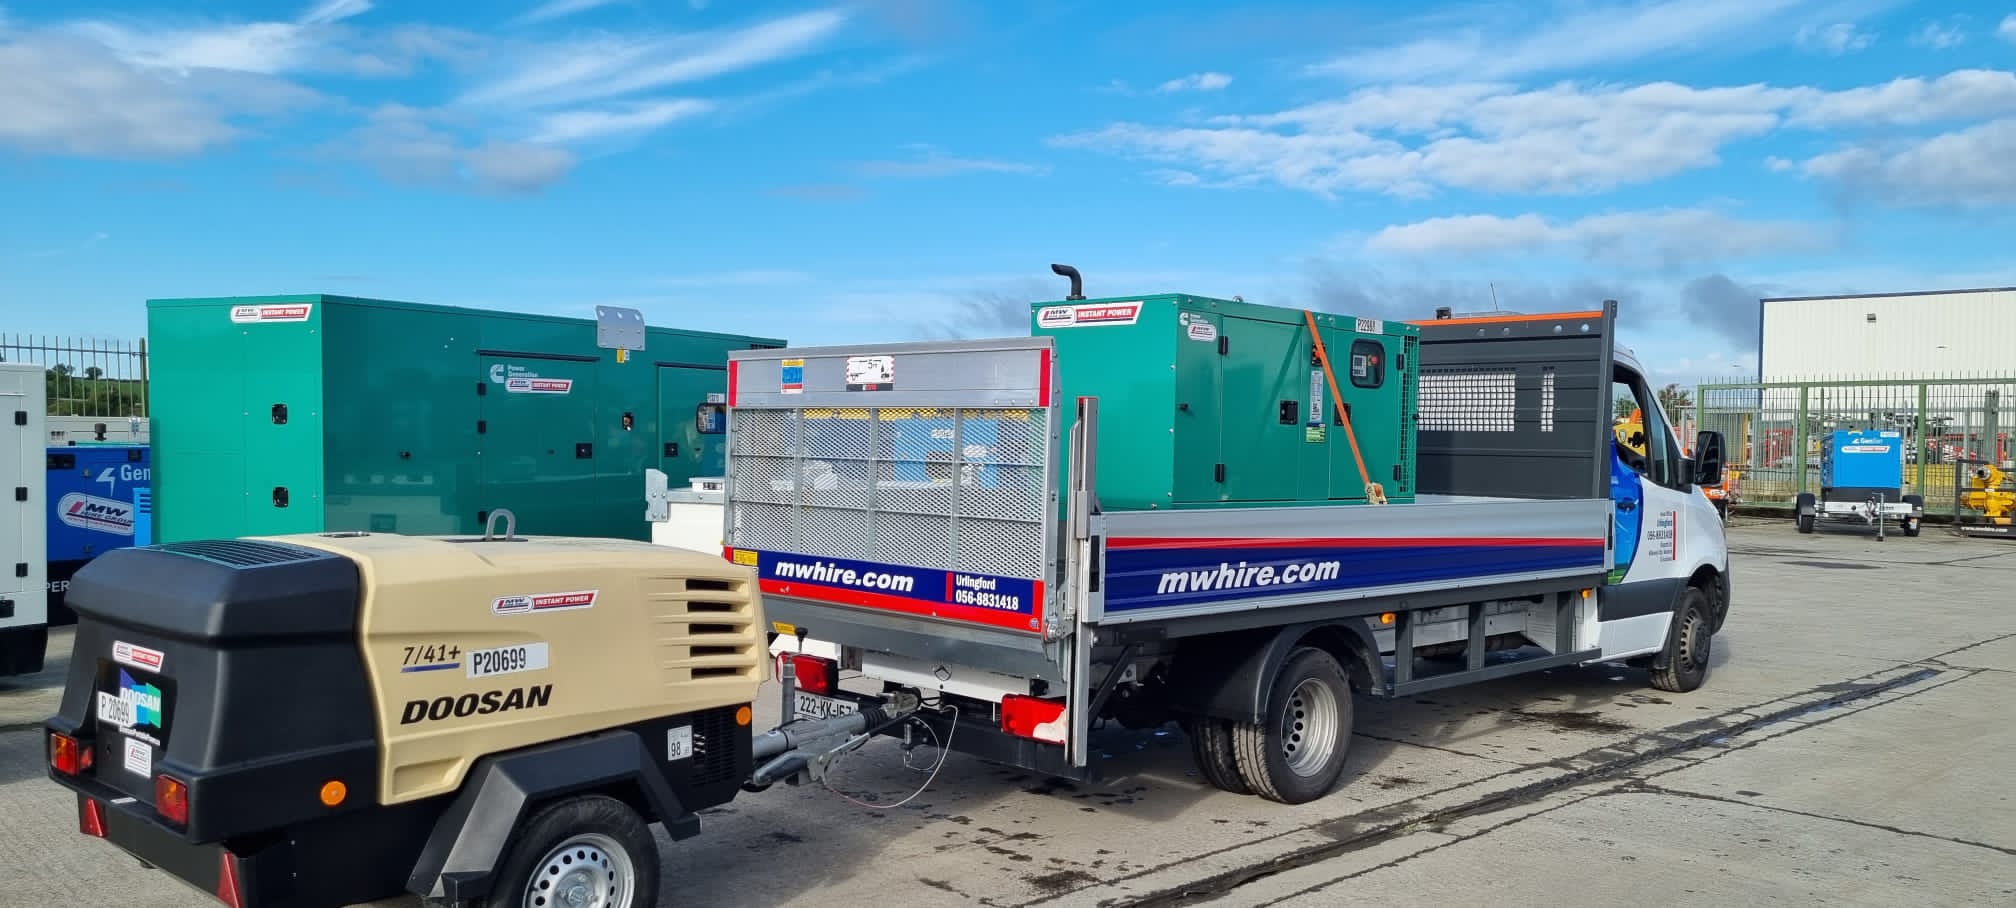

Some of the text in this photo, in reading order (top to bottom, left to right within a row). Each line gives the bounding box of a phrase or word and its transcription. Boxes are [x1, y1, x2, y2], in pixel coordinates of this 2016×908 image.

[1077, 309, 1107, 319] INSTANT
[1107, 307, 1132, 317] POWER
[86, 502, 129, 517] MW
[775, 560, 914, 592] mwhire.com
[956, 574, 996, 591] Urlingford
[1157, 561, 1340, 594] mwhire.com
[535, 597, 564, 606] INSTANT
[565, 595, 589, 604] POWER
[956, 589, 1019, 611] 056-8831418
[402, 644, 461, 665] 7/41+
[473, 647, 526, 675] P20699
[108, 698, 130, 724] 20699
[400, 684, 553, 725] DOOSAN
[671, 741, 680, 757] 98
